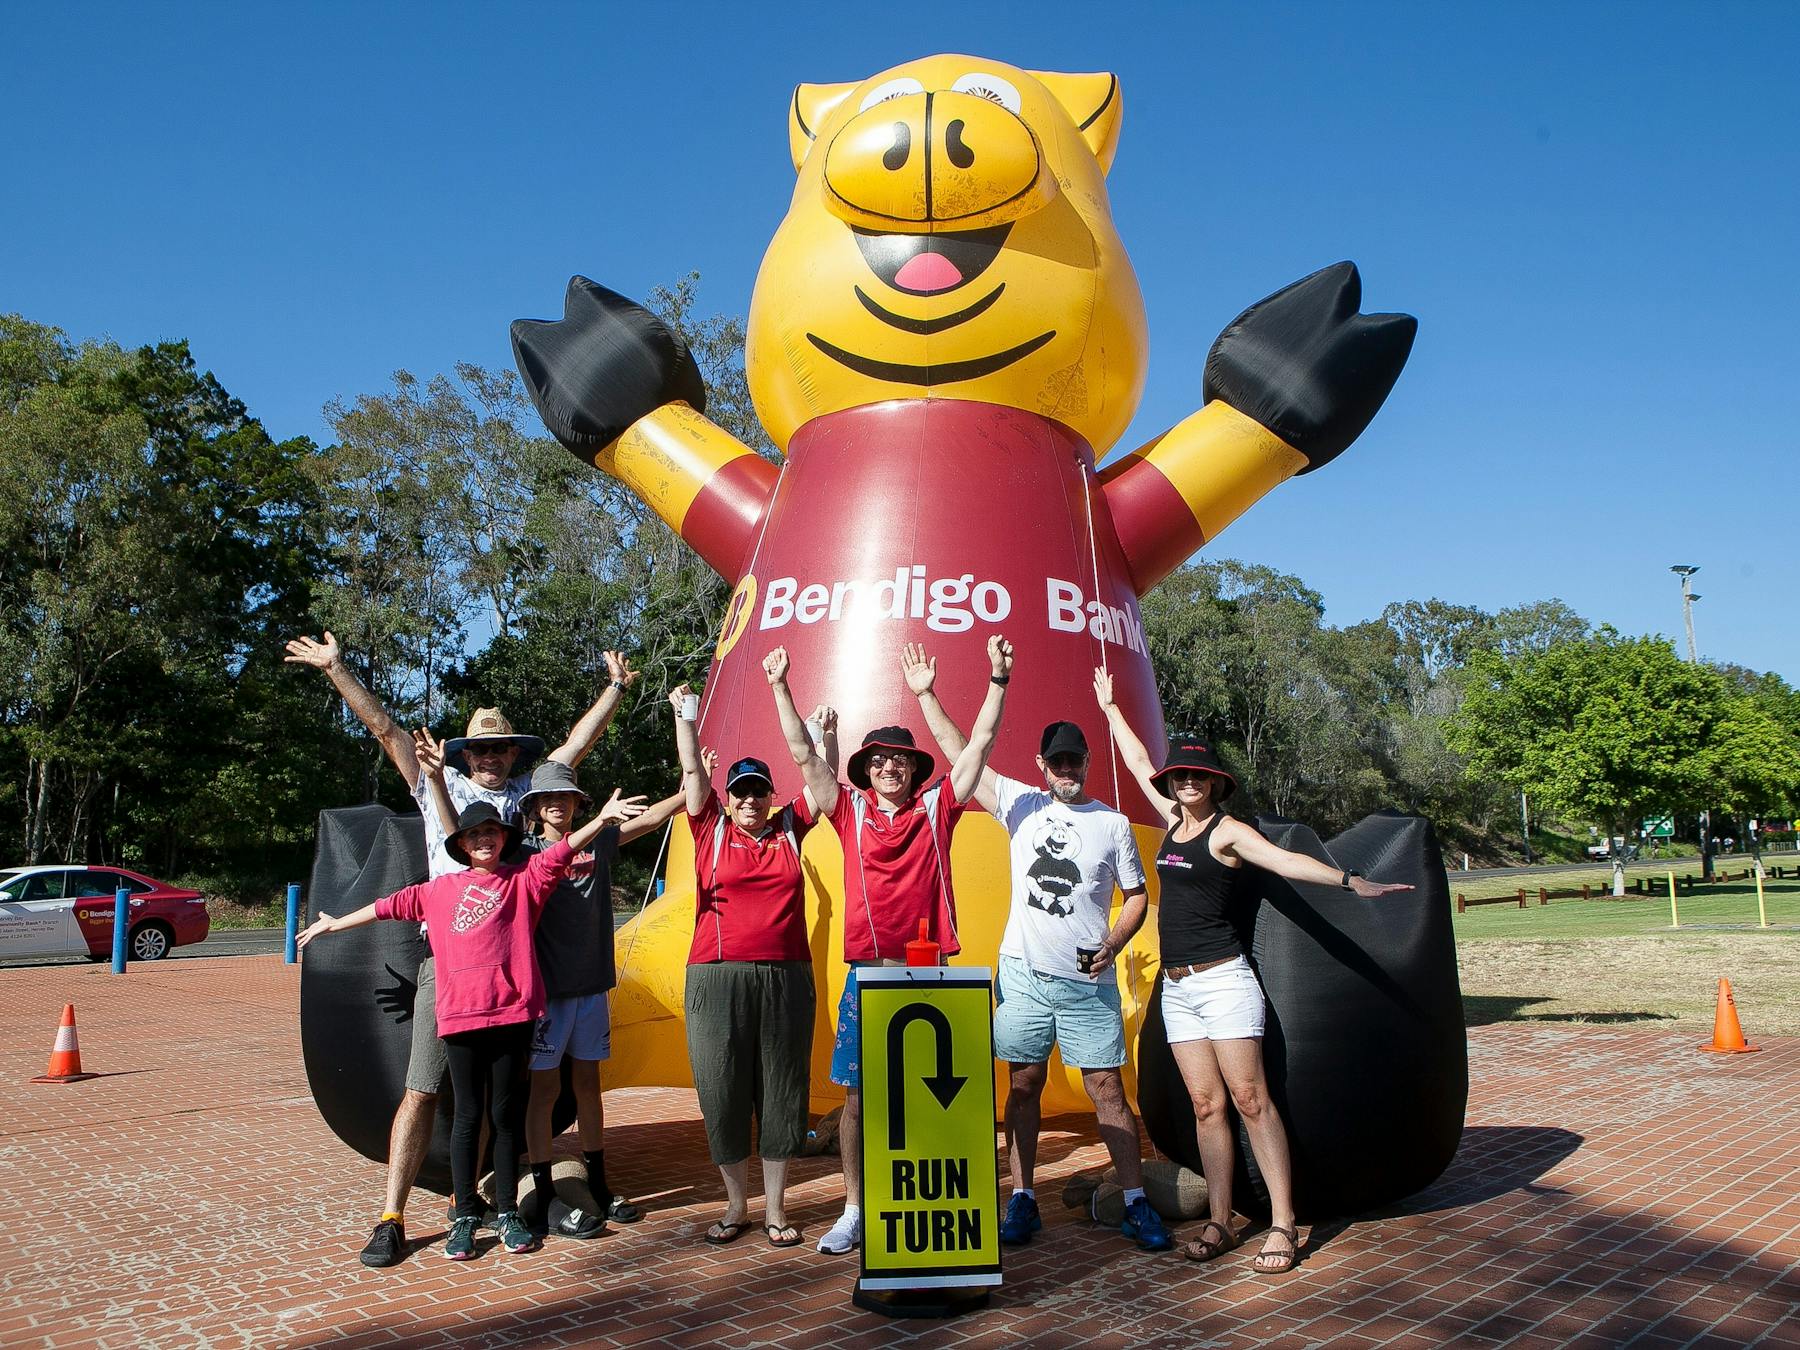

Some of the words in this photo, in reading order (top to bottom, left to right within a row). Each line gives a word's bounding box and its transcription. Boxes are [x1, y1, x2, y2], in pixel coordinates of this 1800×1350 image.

[760, 565, 1011, 632] Bendigo
[1047, 577, 1148, 658] Bank
[456, 893, 503, 931] adidas
[892, 1158, 969, 1201] RUN
[879, 1208, 982, 1253] TURN
